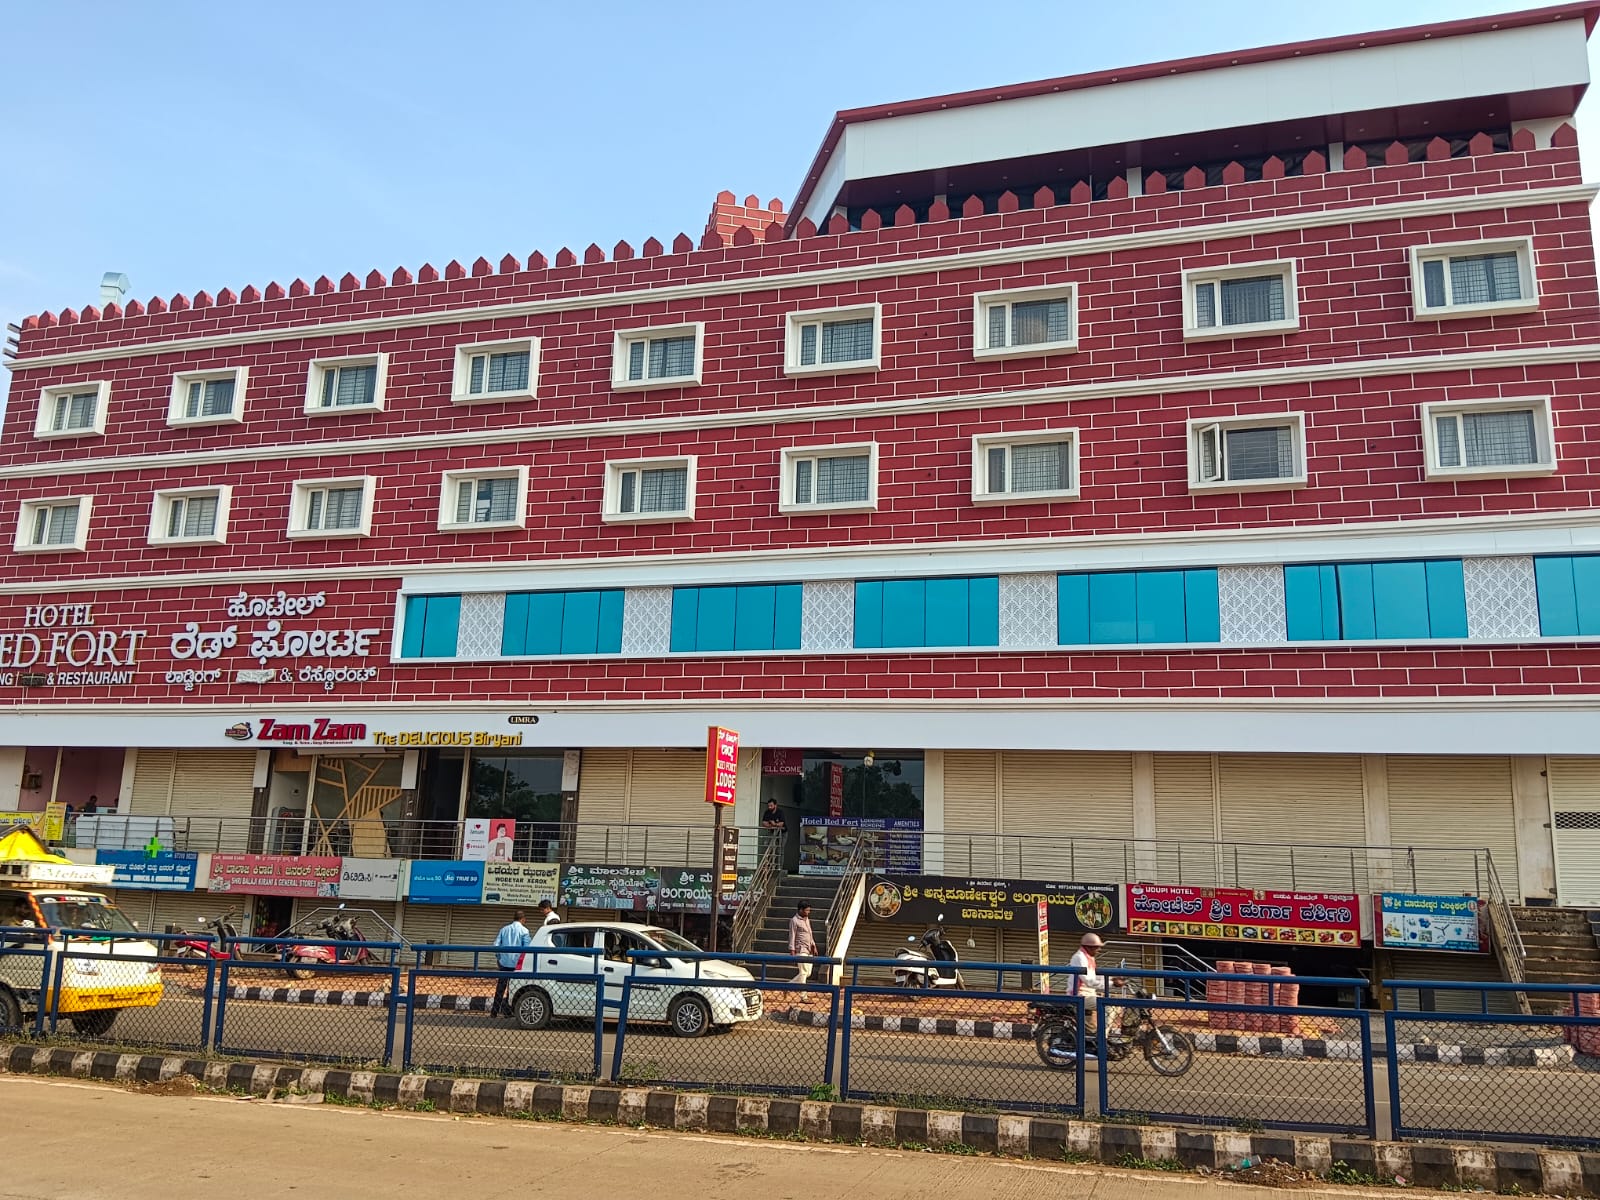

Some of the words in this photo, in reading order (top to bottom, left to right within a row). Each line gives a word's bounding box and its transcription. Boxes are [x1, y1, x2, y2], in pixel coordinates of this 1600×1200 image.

[227, 591, 326, 618] ಹೊಟೇಲ್
[24, 605, 95, 628] HOTEL
[46, 630, 147, 667] FORT
[171, 622, 238, 659] ರೆಡ್
[47, 672, 55, 685] &
[57, 671, 135, 685] RESTAURANT
[280, 668, 293, 682] &
[257, 718, 311, 740] Zam
[312, 718, 366, 740] Zam
[373, 731, 397, 745] The
[399, 731, 472, 745] DELICIOUS
[474, 731, 524, 747] Biryani
[716, 772, 736, 789] LODGE
[800, 817, 822, 826] Hotel
[679, 872, 694, 885] ಶ್ರೀ
[903, 885, 919, 902] ಶ್ರೀ
[1012, 892, 1076, 906] ಲಿಂಗಾಯತ
[961, 908, 1014, 921] ಖಾನಾವಳಿ
[1209, 899, 1232, 922] ಶ್ರೀ
[1238, 899, 1292, 920] ದುರ್ಗಾ
[1300, 903, 1352, 923] ದರ್ಶಿನಿ
